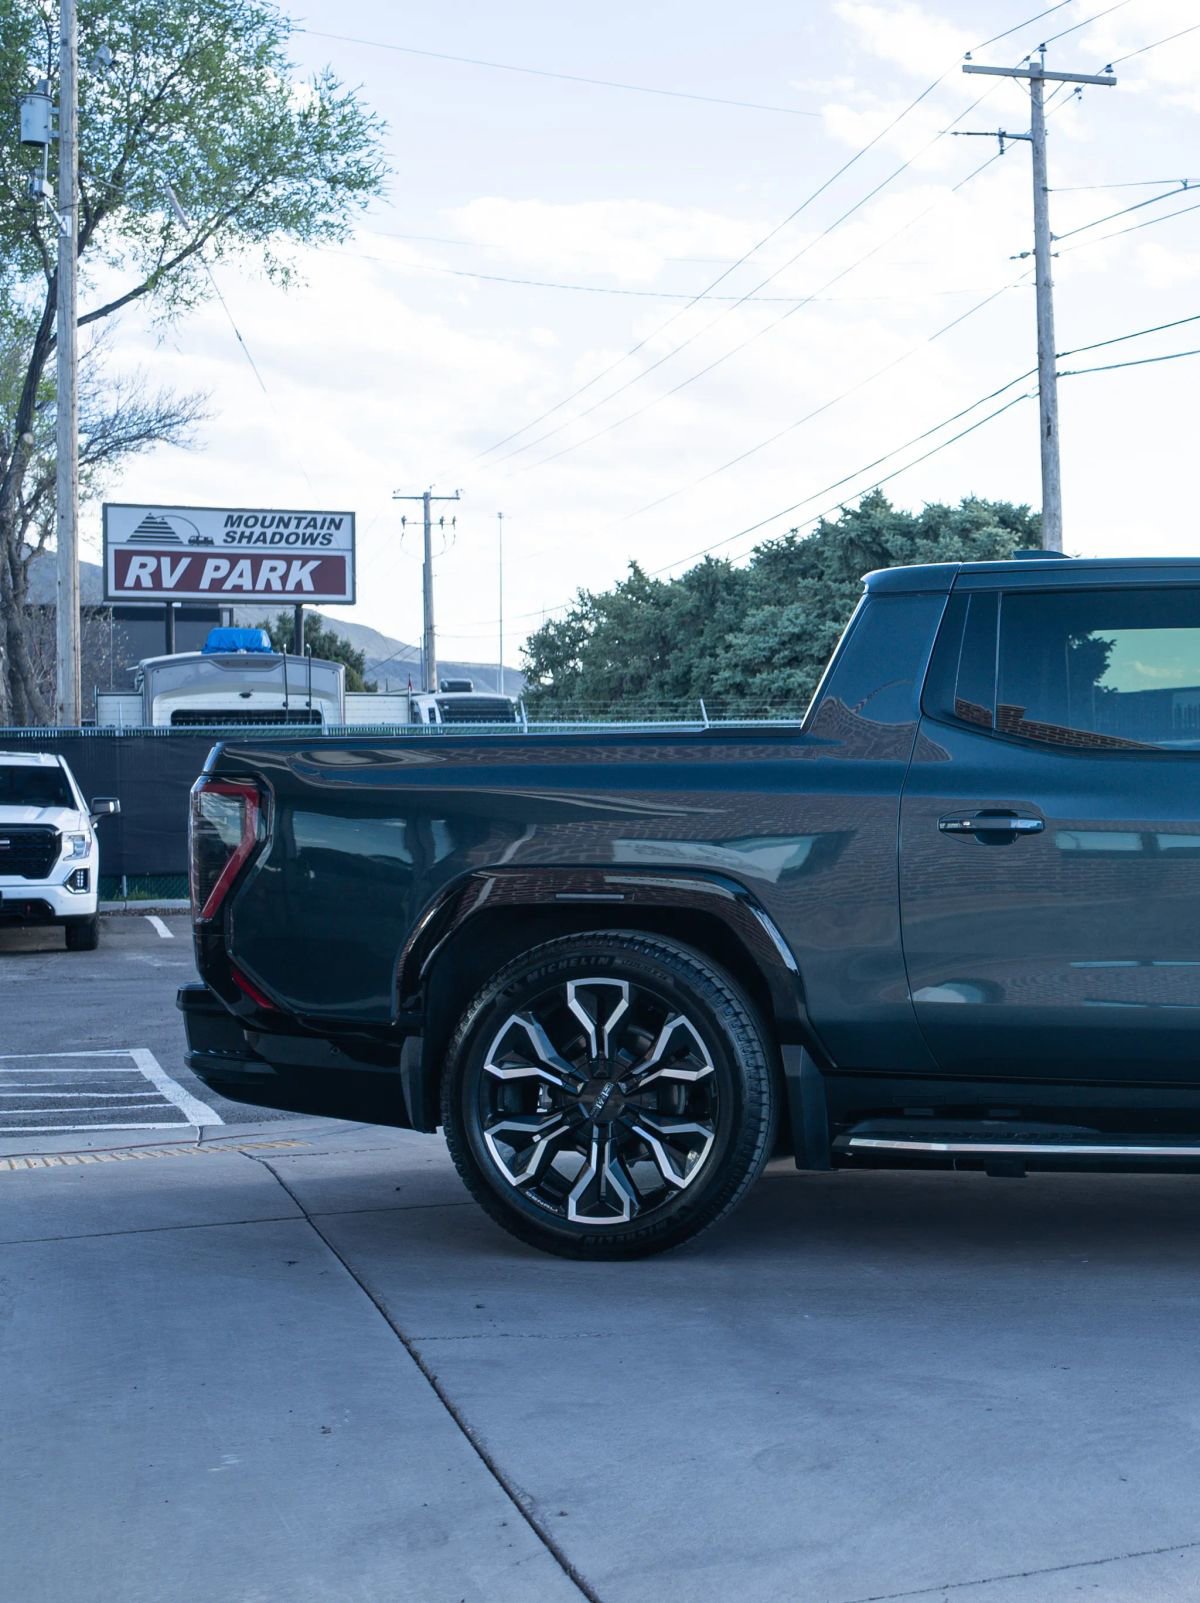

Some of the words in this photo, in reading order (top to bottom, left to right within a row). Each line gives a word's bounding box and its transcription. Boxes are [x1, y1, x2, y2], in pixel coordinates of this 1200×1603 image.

[223, 514, 344, 531] MOUNTAIN
[222, 530, 334, 546] SHADOWS
[123, 555, 192, 588] RV
[199, 558, 322, 591] PARK
[526, 956, 609, 983] MICHELIN
